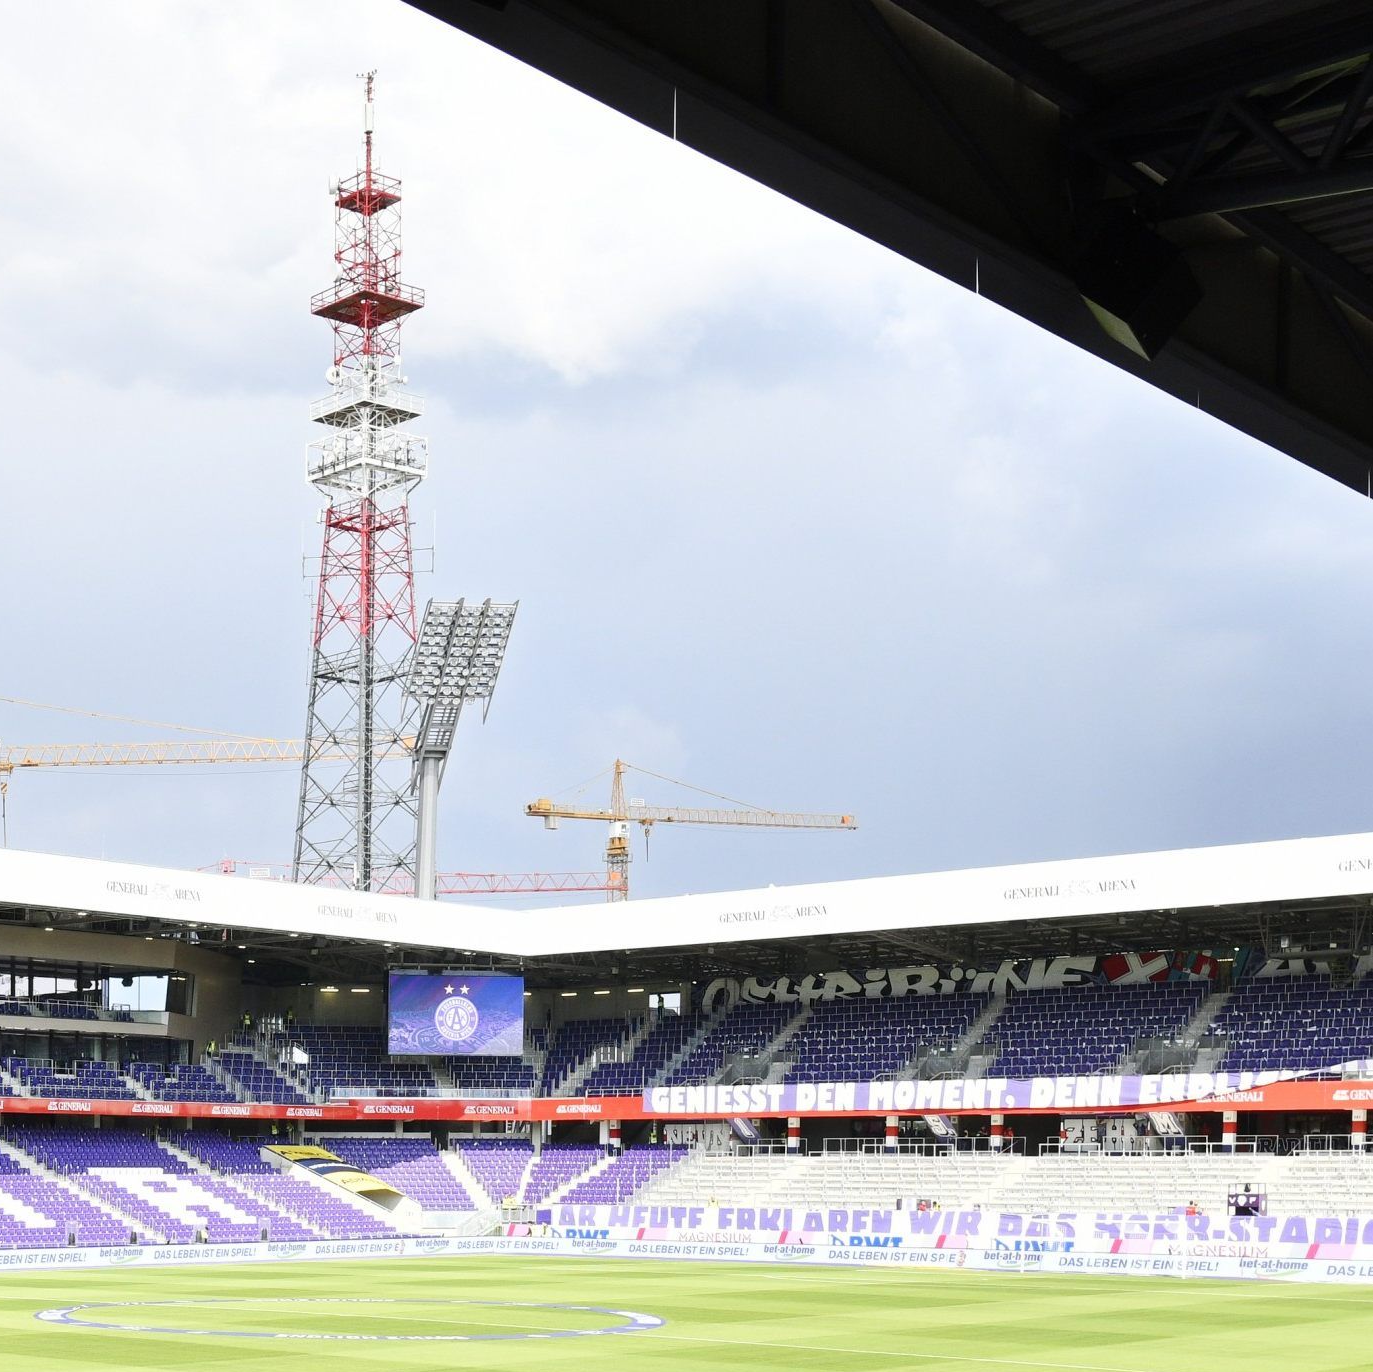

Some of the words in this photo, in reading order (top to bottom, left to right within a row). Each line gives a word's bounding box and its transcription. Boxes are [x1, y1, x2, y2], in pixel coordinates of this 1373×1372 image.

[106, 881, 148, 896] GENERALI
[173, 889, 201, 902] ARENA
[1004, 885, 1059, 900] GENERALI
[1098, 879, 1136, 892] ARENA
[317, 905, 353, 919] GENERALI
[373, 911, 397, 924] ARENA
[719, 911, 765, 924] GENERALI
[793, 904, 828, 917] ARENA
[651, 1085, 782, 1113] GENIESST
[796, 1082, 857, 1111] DEN
[1029, 1076, 1123, 1108] DENN
[58, 1102, 91, 1112] GENERALI
[141, 1104, 173, 1113] GENERALI
[221, 1106, 250, 1115] GENERALI
[294, 1108, 323, 1117] GENERALI
[376, 1105, 414, 1114] GENERALI
[476, 1106, 515, 1115] GENERALI
[567, 1104, 601, 1113] GENERALI
[909, 1210, 982, 1236] WIR
[678, 1232, 751, 1243] MAGNESIUM
[315, 1244, 331, 1254] DAS
[332, 1243, 356, 1253] LEBEN
[357, 1243, 369, 1252] IST
[370, 1243, 383, 1252] EIN
[457, 1241, 472, 1250] DAS
[472, 1240, 494, 1249] LEBEN
[496, 1240, 512, 1249] IST
[514, 1240, 529, 1249] EIN
[531, 1241, 559, 1250] SPIEL!
[572, 1239, 617, 1248] bet-at-home
[154, 1250, 171, 1259] DAS
[173, 1249, 200, 1259] LEBEN
[202, 1248, 215, 1258] IST
[216, 1248, 230, 1257] EIN
[231, 1247, 256, 1257] SPIEL!
[628, 1244, 647, 1253] DAS
[649, 1244, 681, 1254] LEBEN
[682, 1245, 698, 1254] IST
[699, 1246, 716, 1255] EIN
[719, 1246, 749, 1256] SPIEL!
[764, 1244, 815, 1255] bet-at-home
[24, 1254, 39, 1264] IST
[40, 1254, 56, 1263] EIN
[58, 1253, 86, 1262] SPIEL!
[829, 1250, 849, 1260] DAS
[853, 1250, 887, 1261] LEBEN
[890, 1251, 907, 1262] IST
[909, 1252, 928, 1263] EIN
[984, 1251, 1043, 1262] bet-at-hme
[1058, 1256, 1084, 1267] DAS
[1087, 1257, 1128, 1268] LEBEN
[1131, 1258, 1150, 1269] IST
[1153, 1259, 1174, 1270] EIN
[1239, 1258, 1308, 1270] bet-at-home
[1327, 1265, 1355, 1276] DAS
